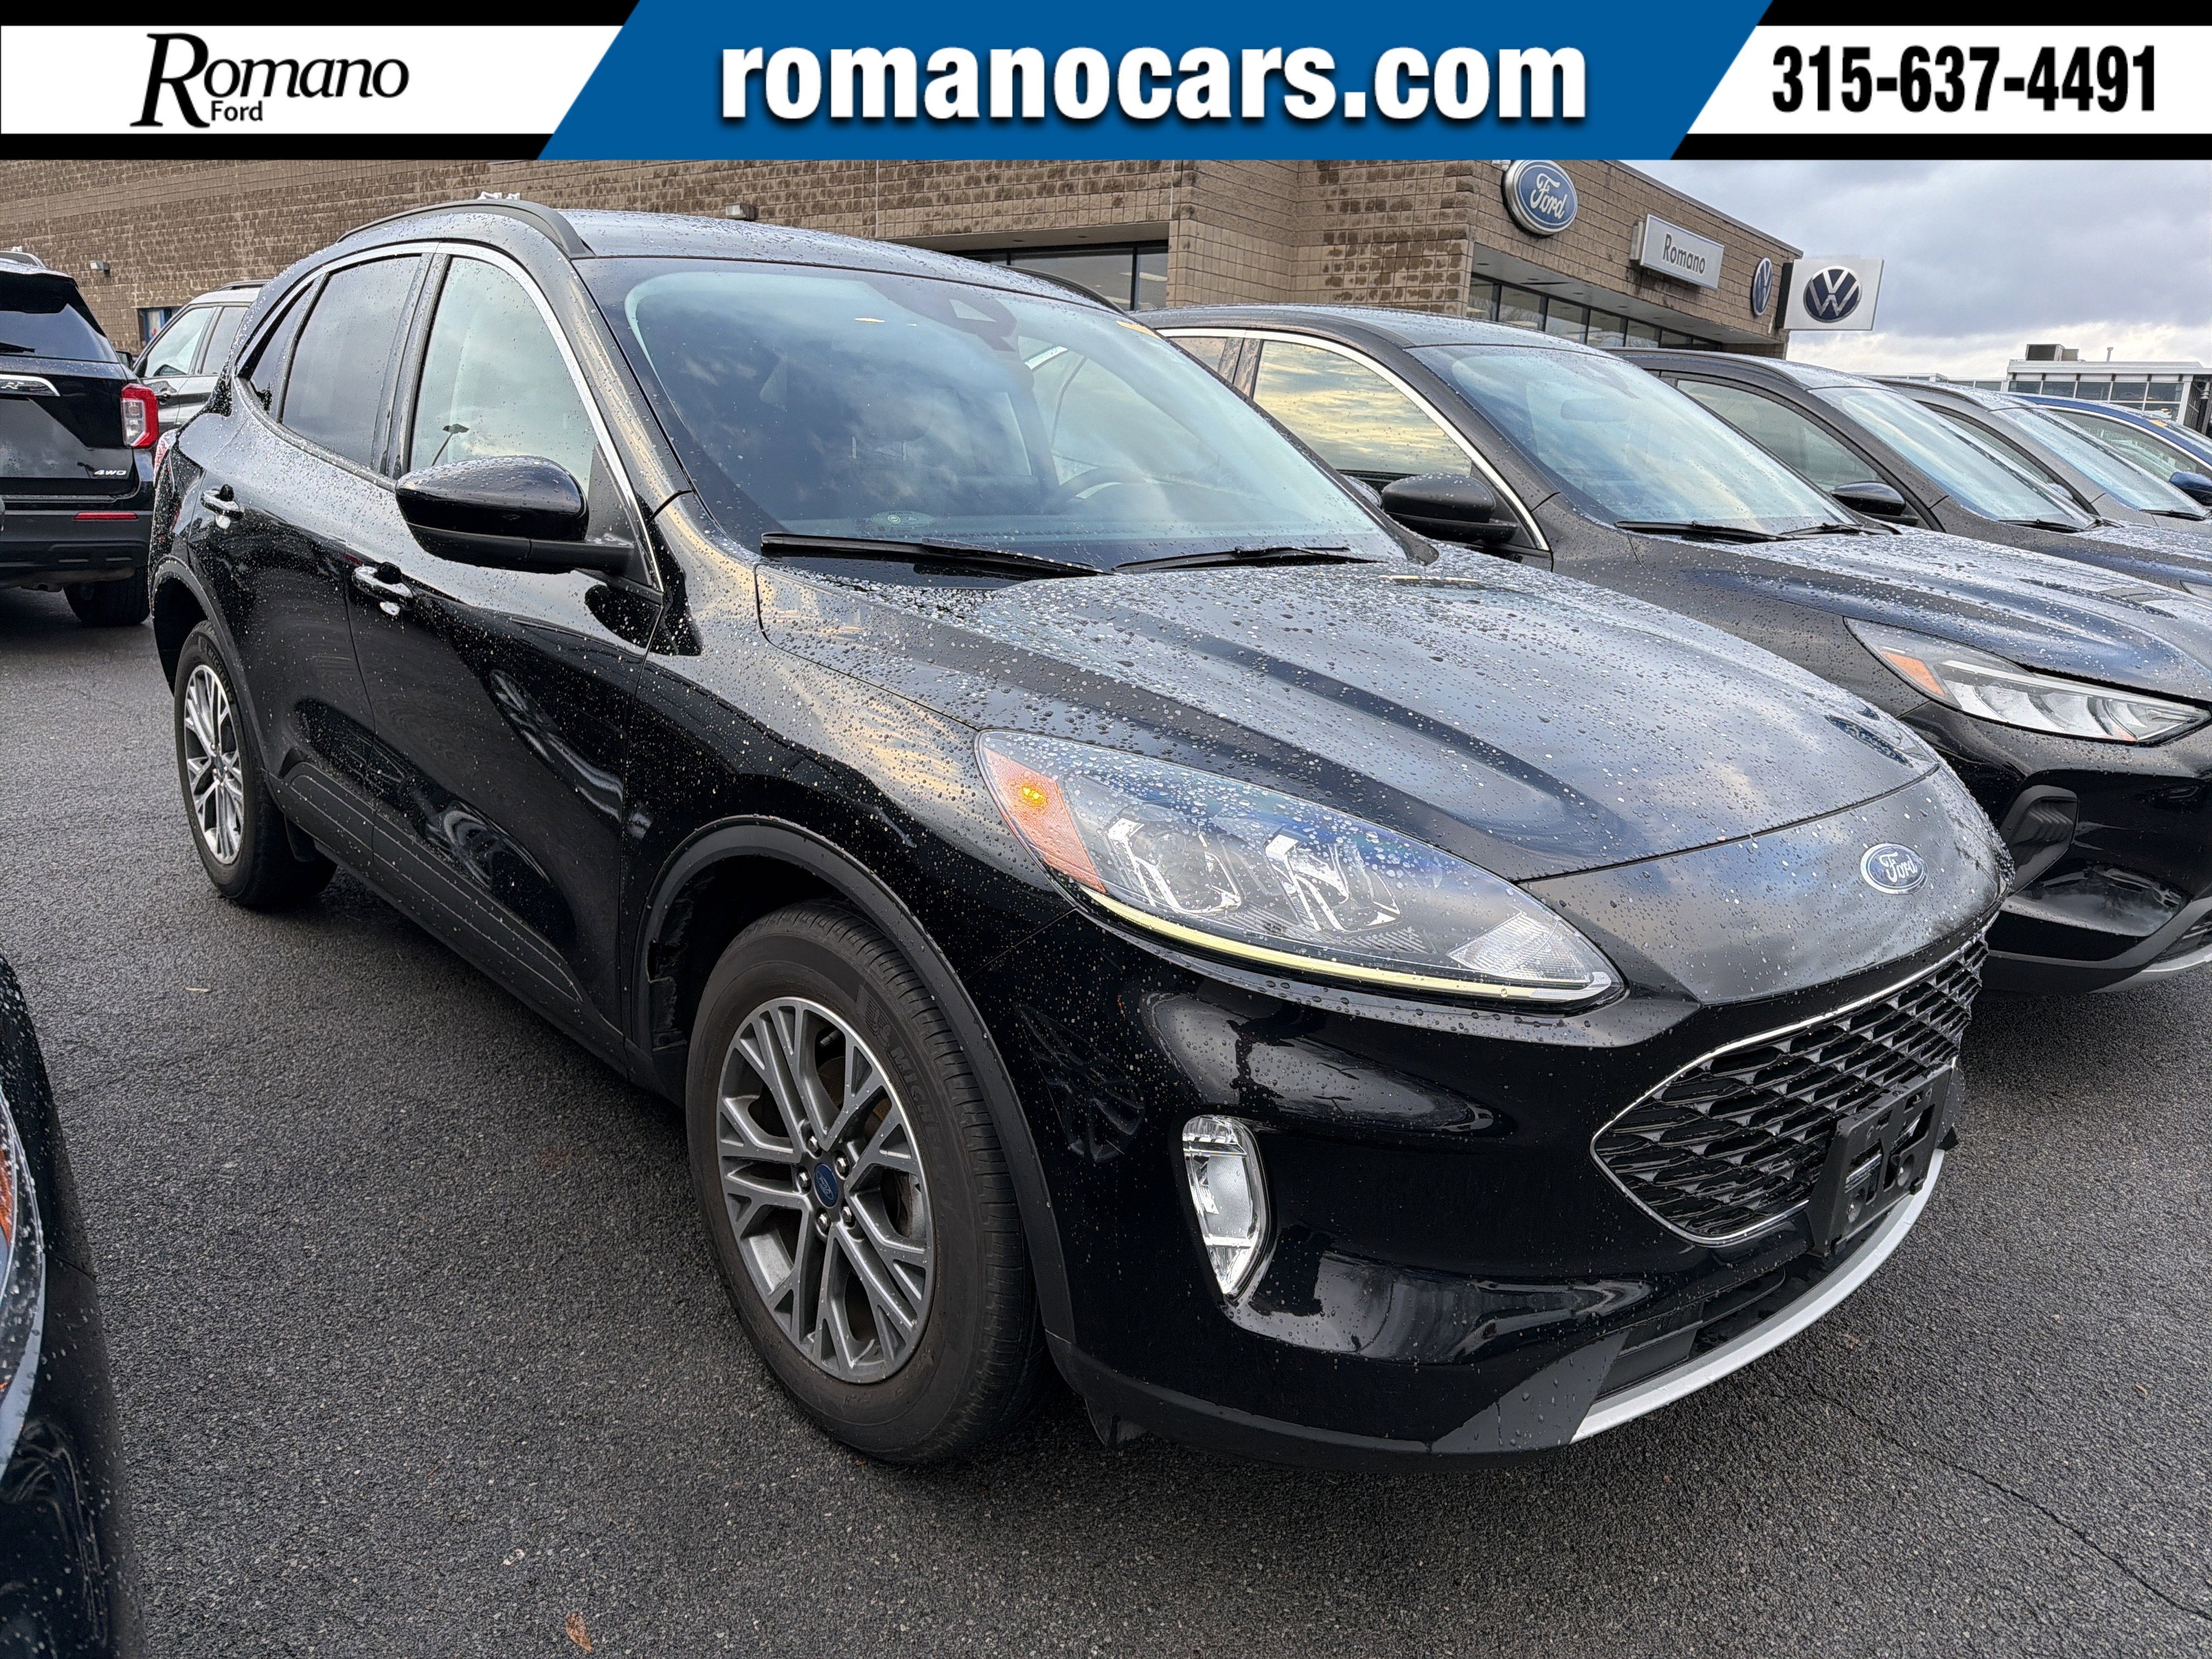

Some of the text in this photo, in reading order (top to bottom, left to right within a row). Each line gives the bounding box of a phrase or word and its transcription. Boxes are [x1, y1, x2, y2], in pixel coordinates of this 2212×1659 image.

[1530, 173, 1568, 219] Ford
[1662, 233, 1706, 274] Romano
[1878, 851, 1918, 883] Ford
